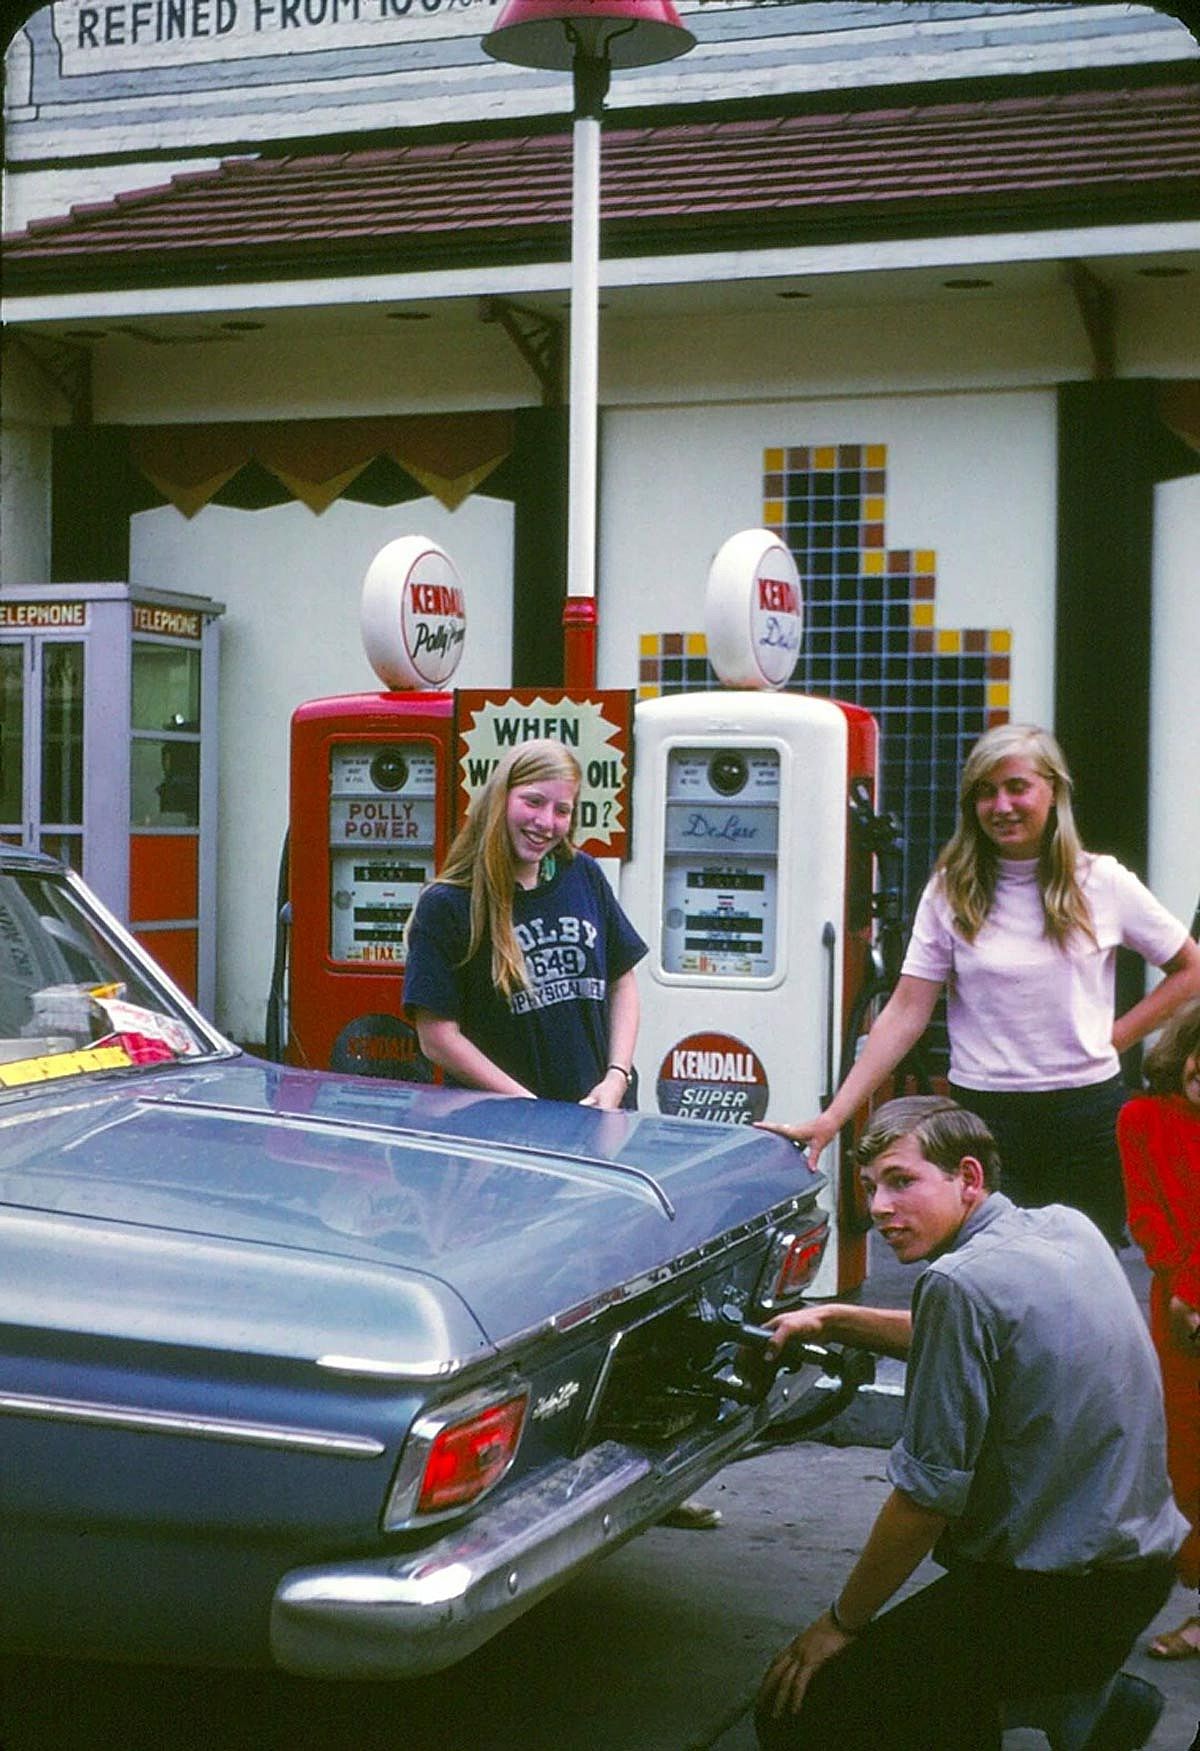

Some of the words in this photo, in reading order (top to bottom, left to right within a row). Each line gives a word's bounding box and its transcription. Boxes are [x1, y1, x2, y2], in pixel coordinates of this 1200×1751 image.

[78, 0, 238, 49] REFINED
[255, 0, 359, 31] FROM
[0, 604, 84, 628] ELEPHONE
[134, 608, 198, 635] TELEPHONE
[494, 718, 579, 746] WHEN
[587, 760, 621, 788] OIL
[349, 803, 414, 820] POLLY
[345, 822, 418, 838] POWER
[514, 917, 597, 951] OLBY
[672, 1051, 757, 1082] KENDALL
[681, 1089, 748, 1108] SUPER
